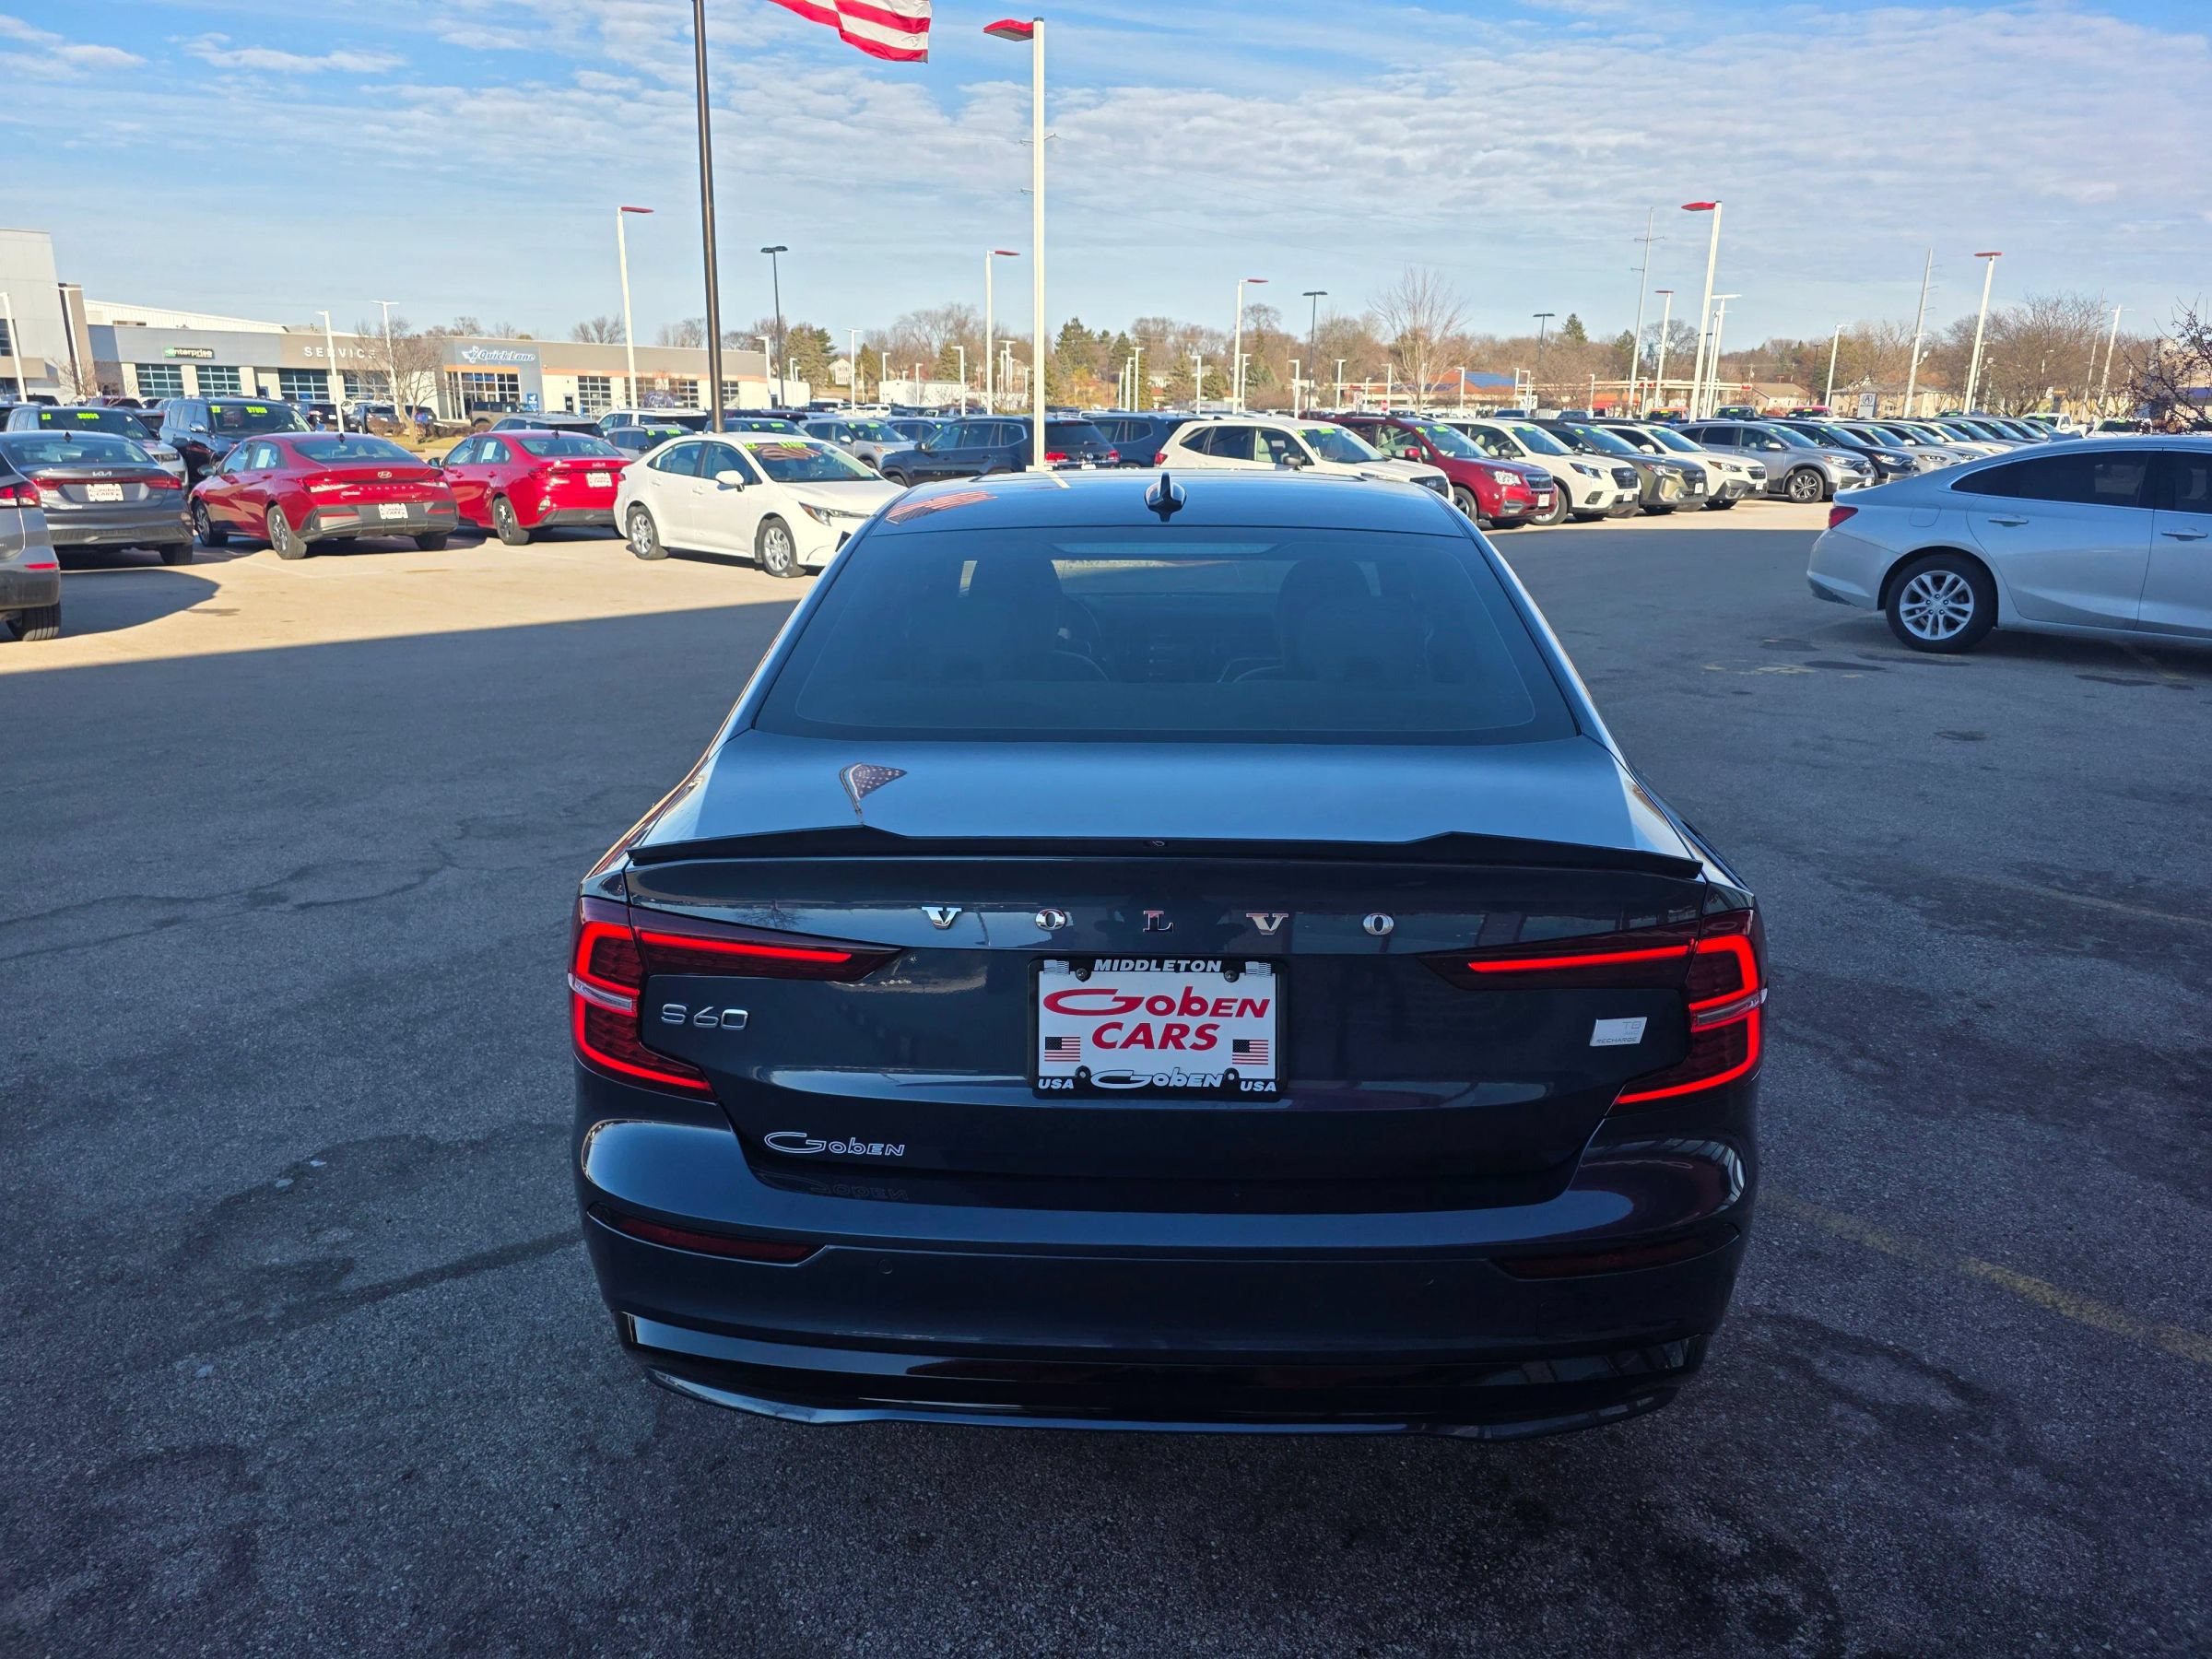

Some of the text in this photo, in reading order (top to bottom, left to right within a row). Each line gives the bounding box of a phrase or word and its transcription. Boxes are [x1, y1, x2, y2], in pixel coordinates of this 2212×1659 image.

[478, 349, 536, 361] Quick Lane
[921, 906, 1394, 935] VOLVO
[1093, 959, 1222, 973] MIDDLETON
[660, 1003, 749, 1030] S60
[1091, 1021, 1222, 1051] CARS
[1038, 1077, 1075, 1090] USA
[1240, 1079, 1277, 1093] USA
